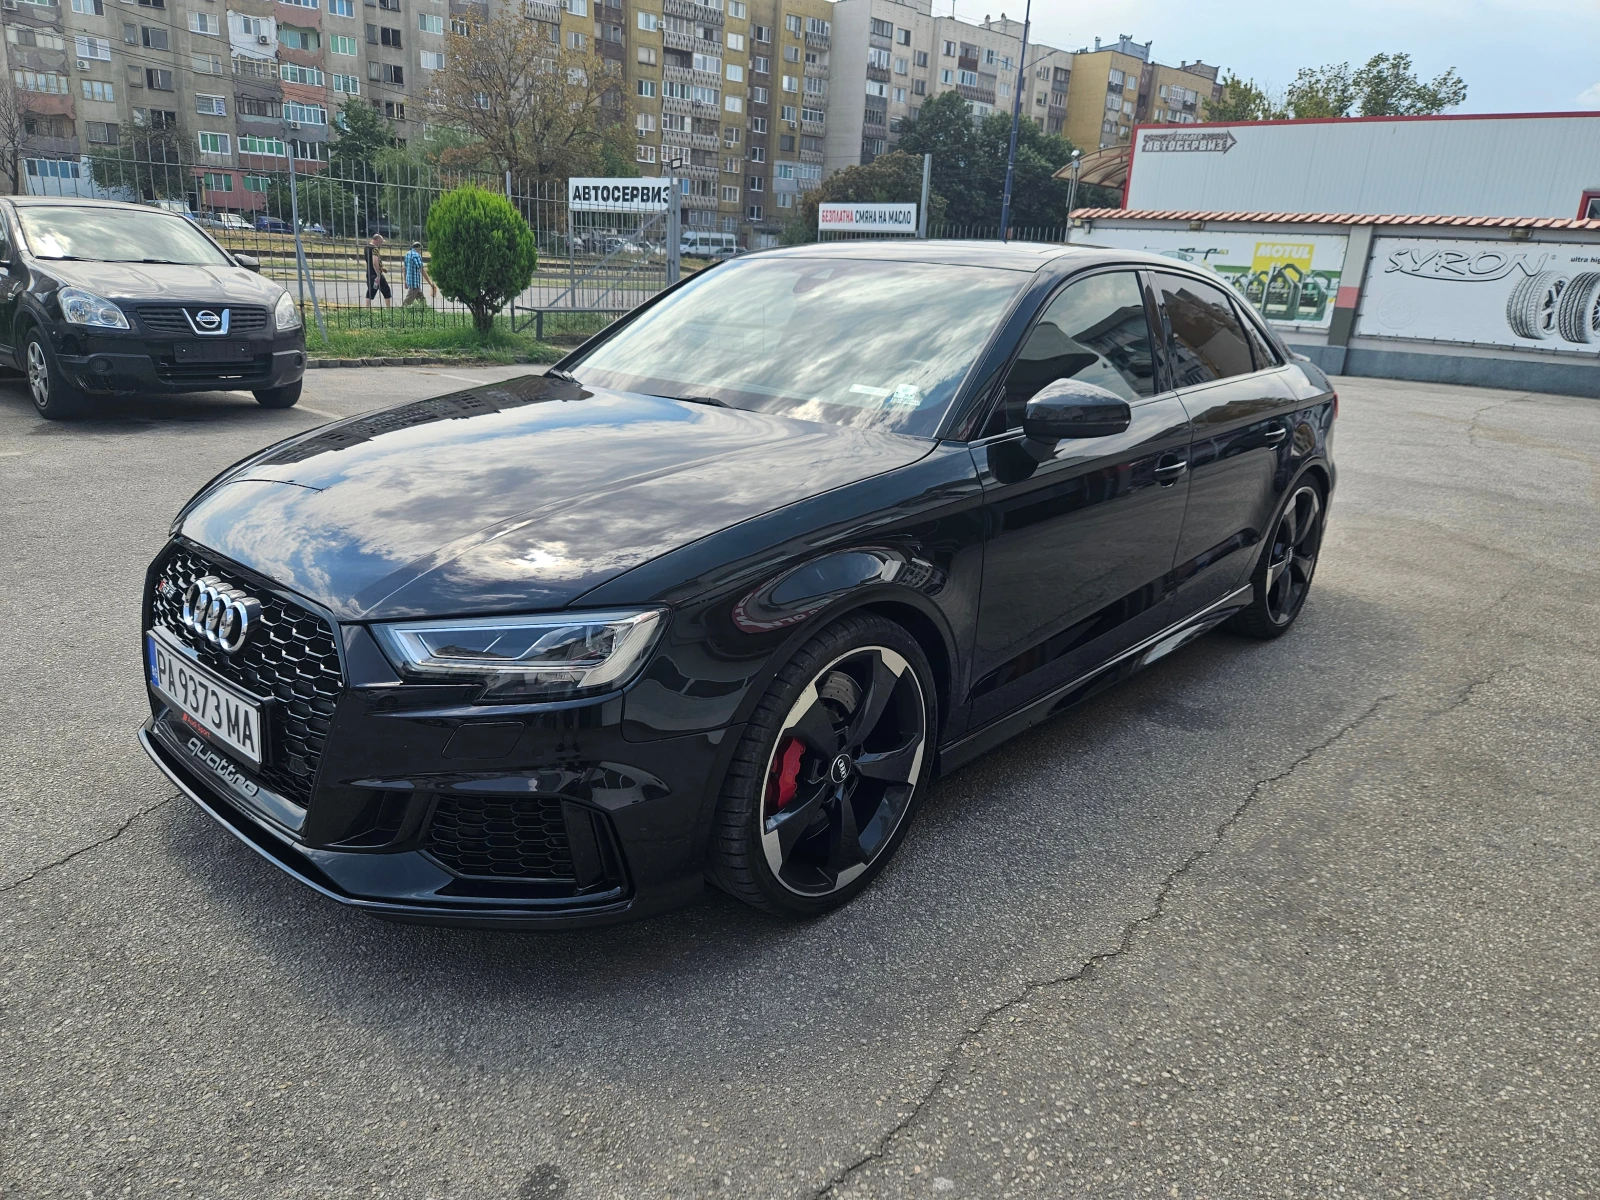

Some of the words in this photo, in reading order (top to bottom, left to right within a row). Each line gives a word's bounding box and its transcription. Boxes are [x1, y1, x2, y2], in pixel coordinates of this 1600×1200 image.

[1145, 140, 1223, 151] АВТОСЕРВИЗ
[573, 185, 670, 203] АВТОСЕРВИЗ
[822, 210, 853, 223] БЕЗПЛАТНА
[855, 210, 876, 224] СМЯНА
[878, 210, 886, 224] НА
[888, 210, 911, 225] МАСЛО
[1256, 245, 1310, 258] MOTUL
[1384, 248, 1549, 282] SYRON
[187, 737, 259, 797] quattro
